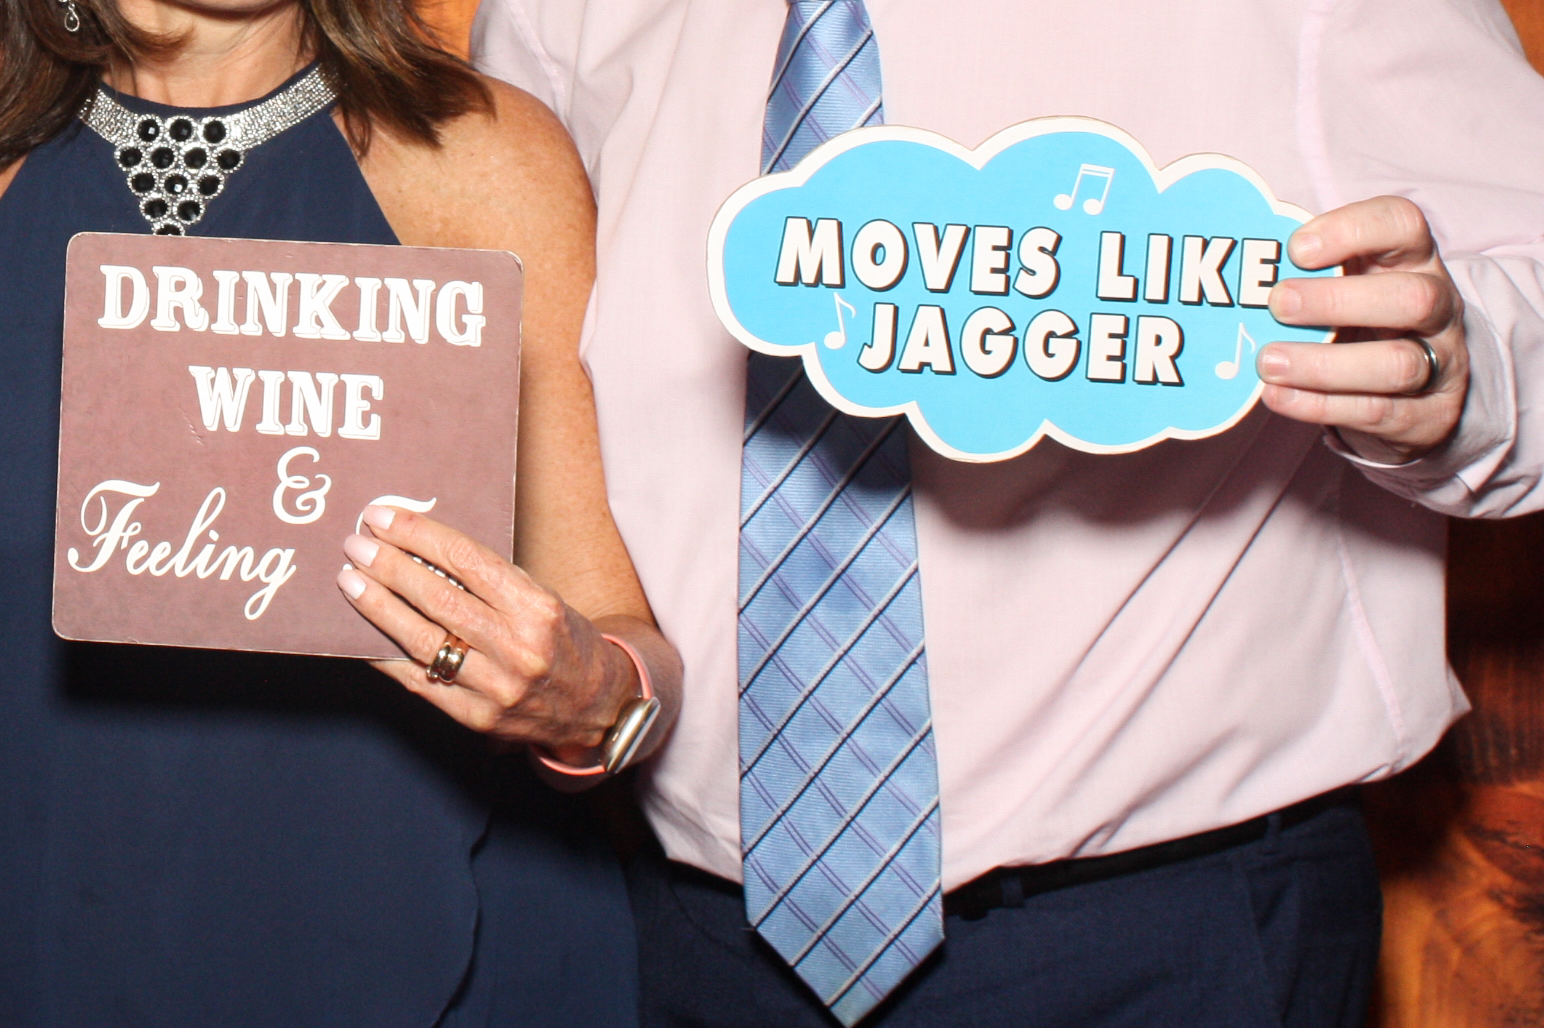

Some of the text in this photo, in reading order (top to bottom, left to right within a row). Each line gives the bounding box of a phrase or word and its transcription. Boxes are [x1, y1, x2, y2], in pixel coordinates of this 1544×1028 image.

[774, 216, 1280, 309] MOVES LIKE
[97, 264, 486, 347] DRINKING
[858, 302, 1185, 386] JAGGER
[188, 365, 384, 440] WINE
[272, 446, 332, 524] &
[67, 479, 297, 621] Feeling
